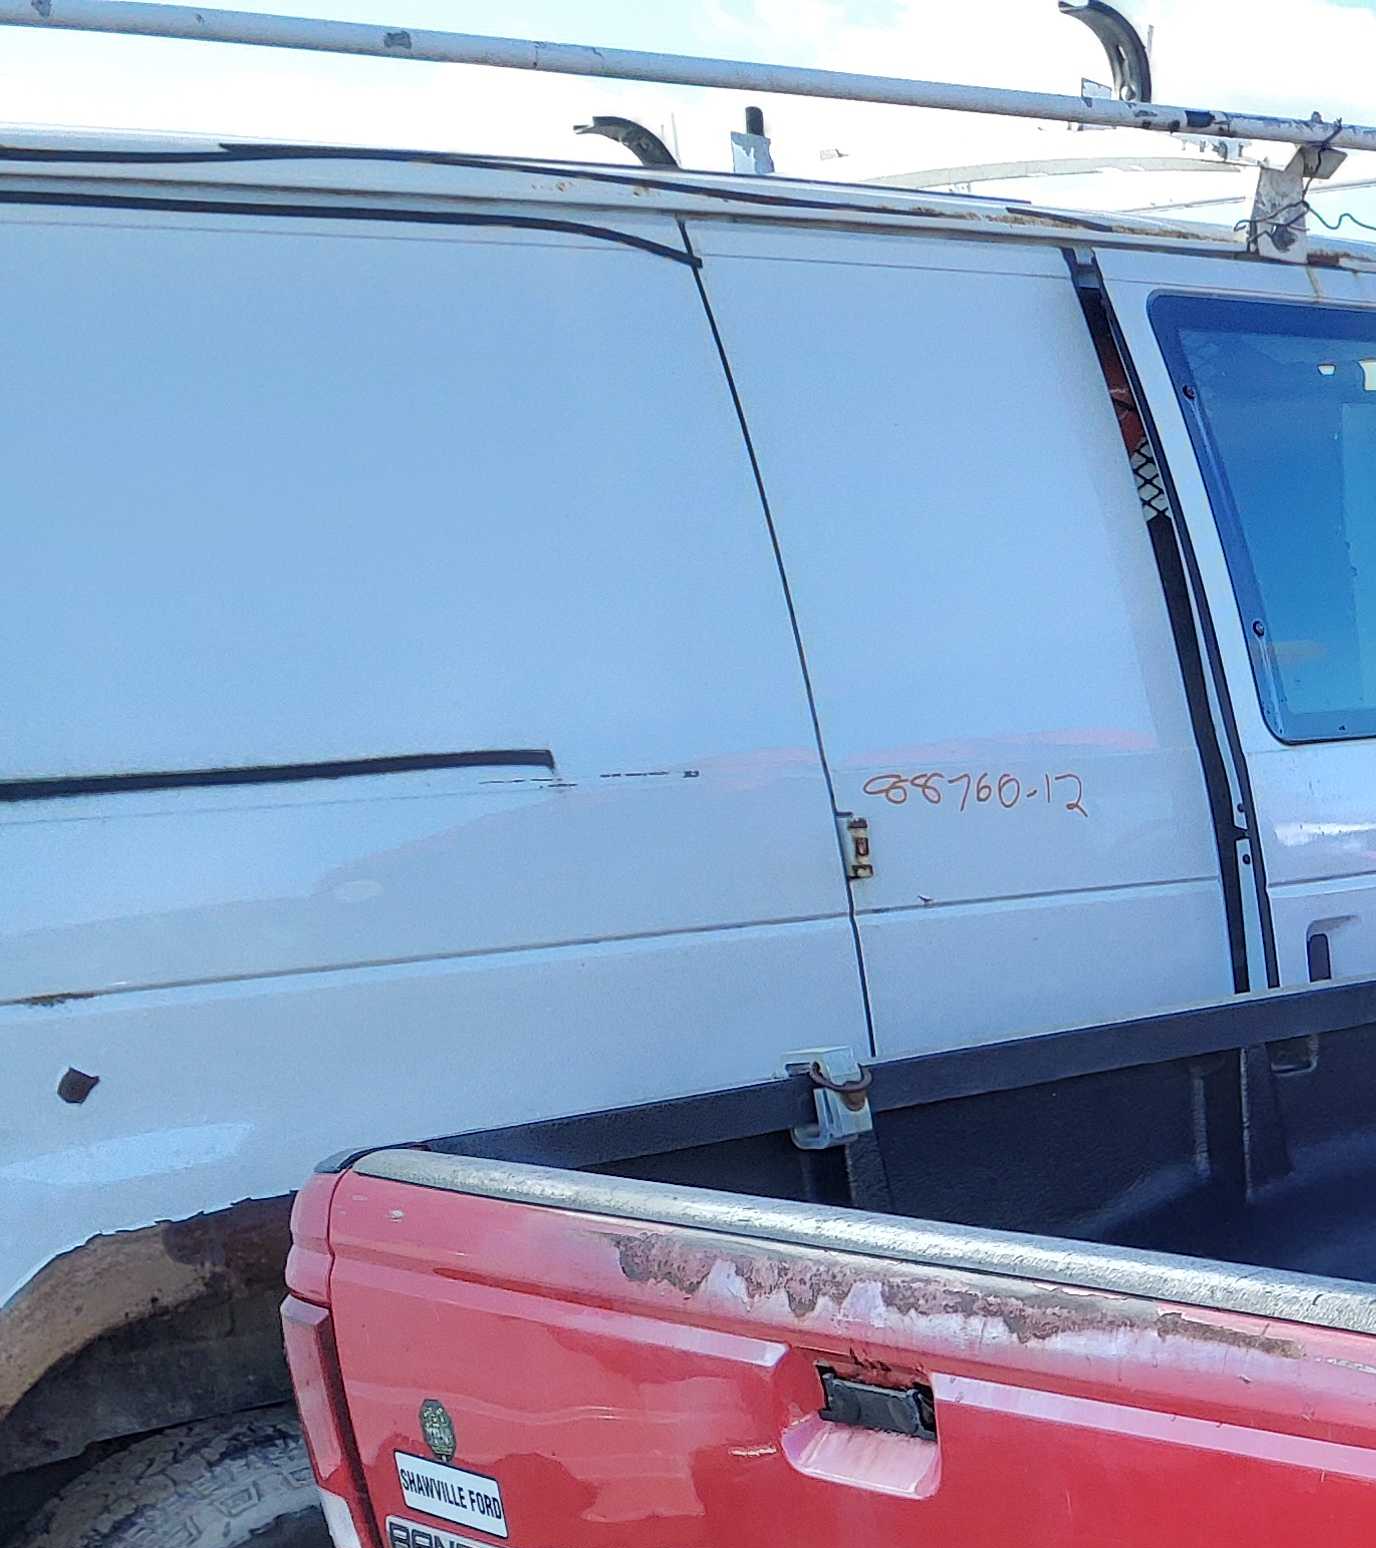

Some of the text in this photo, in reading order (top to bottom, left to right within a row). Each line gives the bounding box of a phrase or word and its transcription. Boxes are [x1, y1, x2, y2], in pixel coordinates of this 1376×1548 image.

[862, 772, 1089, 818] 88760-12
[400, 1468, 502, 1521] SHAWVILLE FORD
